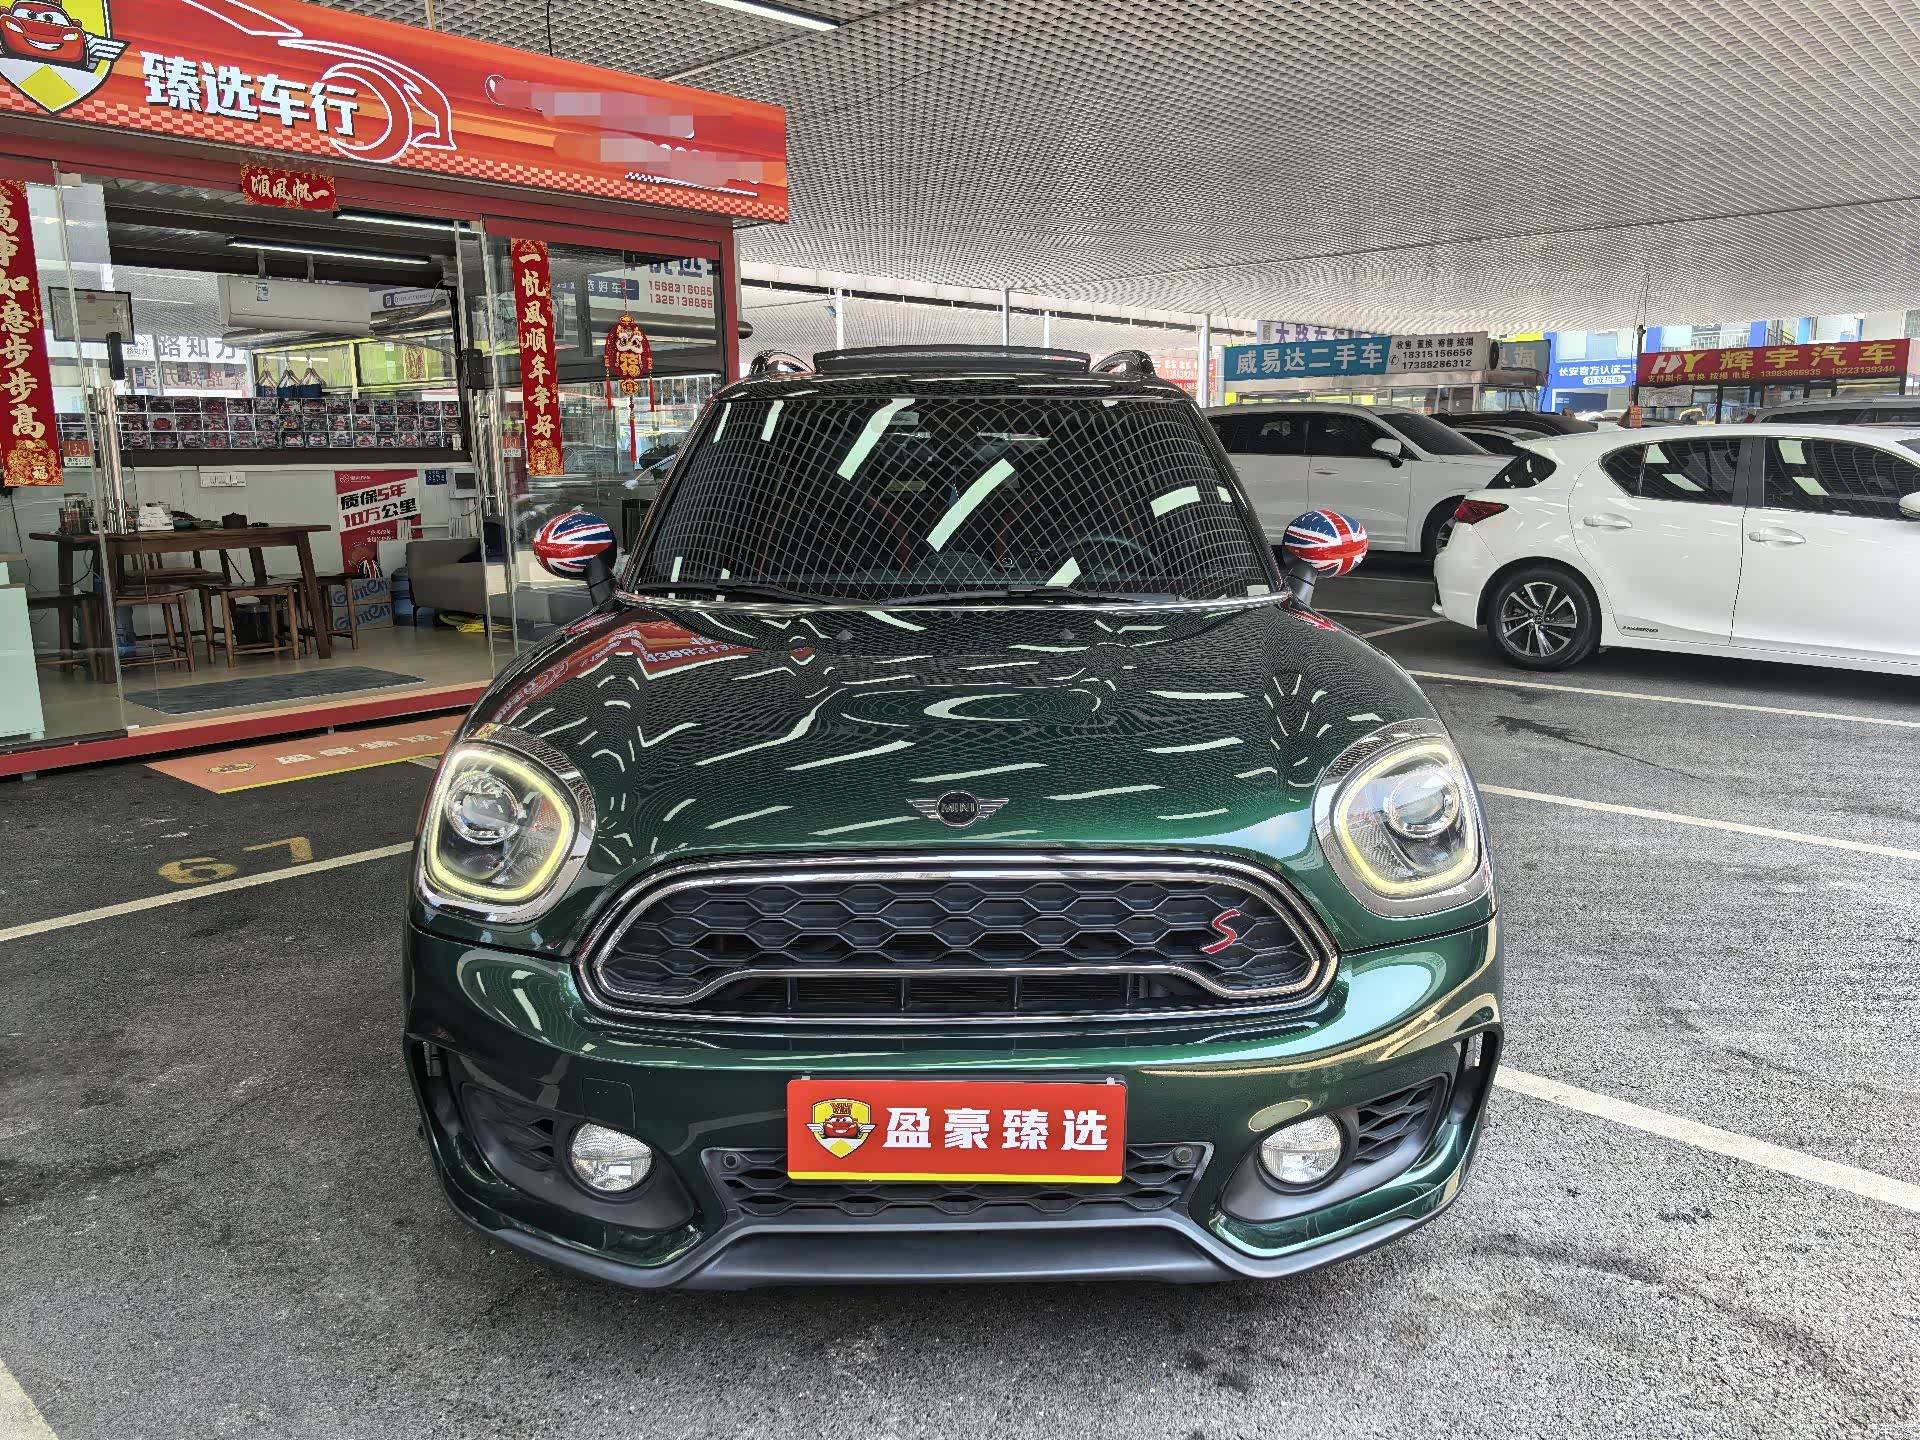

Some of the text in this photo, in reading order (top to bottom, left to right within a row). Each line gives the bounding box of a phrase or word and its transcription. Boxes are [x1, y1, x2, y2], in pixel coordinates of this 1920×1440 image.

[140, 50, 360, 137] 臻选车行
[1236, 342, 1383, 375] 威易达二手车
[1402, 348, 1473, 359] 18315156656
[1402, 359, 1472, 370] 17388286312
[1719, 343, 1896, 370] 辉宇汽车
[340, 483, 407, 510] 质保5年
[343, 498, 418, 528] 10万公里
[941, 802, 975, 813] MINI
[158, 836, 314, 884] 67
[1201, 908, 1241, 954] S
[881, 1107, 1109, 1151] 盈豪臻选
